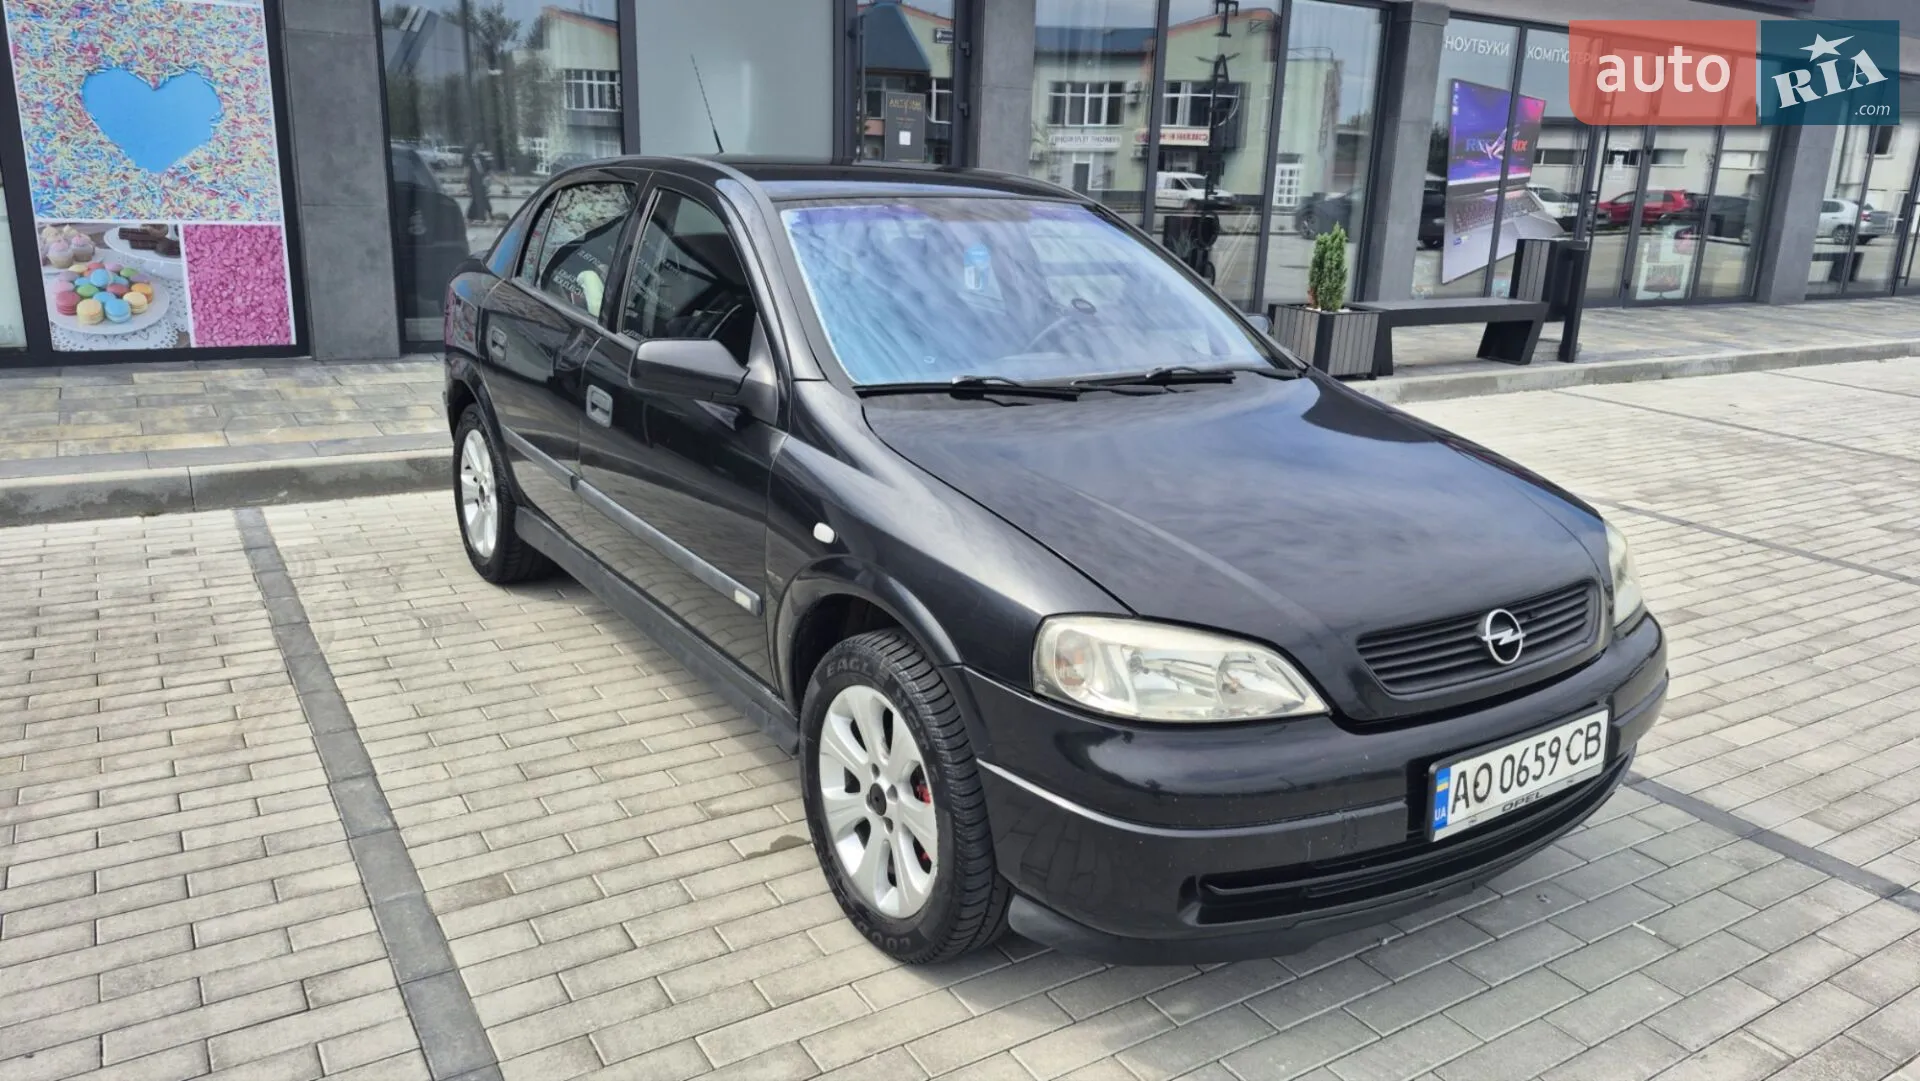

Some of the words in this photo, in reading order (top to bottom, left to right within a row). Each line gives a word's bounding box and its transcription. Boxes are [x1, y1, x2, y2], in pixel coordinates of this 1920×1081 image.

[1445, 35, 1511, 57] НОУТБУКИ
[1451, 762, 1493, 814] AO
[1499, 736, 1562, 795] 0659
[1566, 720, 1602, 766] CB
[1501, 790, 1547, 812] OPEL
[1435, 808, 1447, 821] UA
